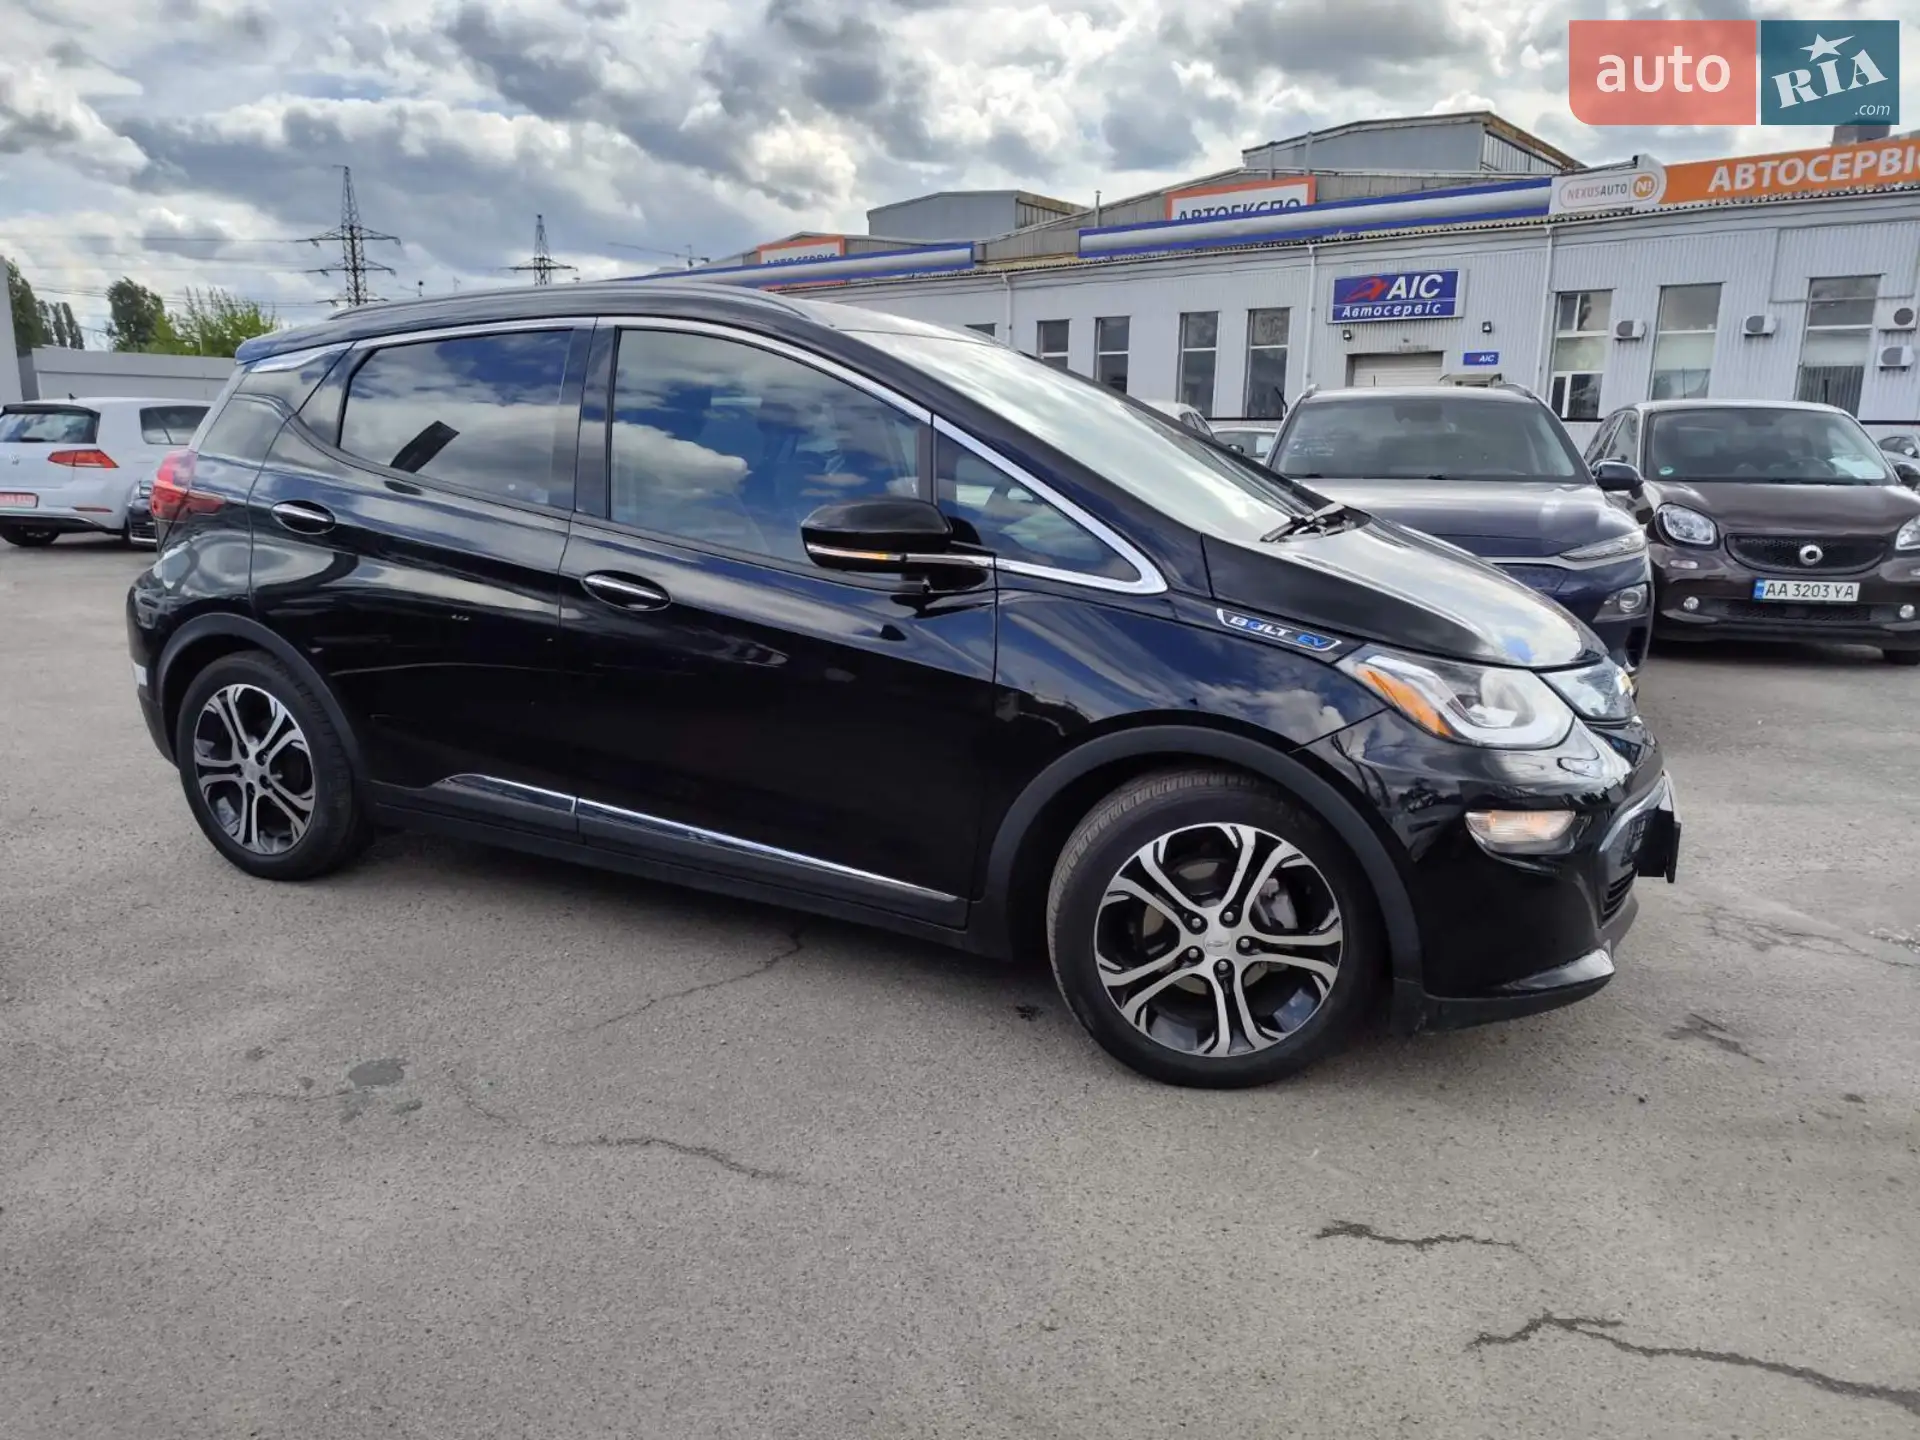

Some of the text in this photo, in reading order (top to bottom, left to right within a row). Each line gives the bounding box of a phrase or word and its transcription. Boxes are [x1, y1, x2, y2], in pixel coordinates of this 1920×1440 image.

[1707, 146, 1920, 193] АВТОСЕРВІ
[1566, 183, 1628, 200] NEXUSAUTO
[1341, 301, 1441, 318] Автосервіс
[1765, 583, 1854, 599] AA 3203 YA
[1229, 616, 1292, 637] BOLT
